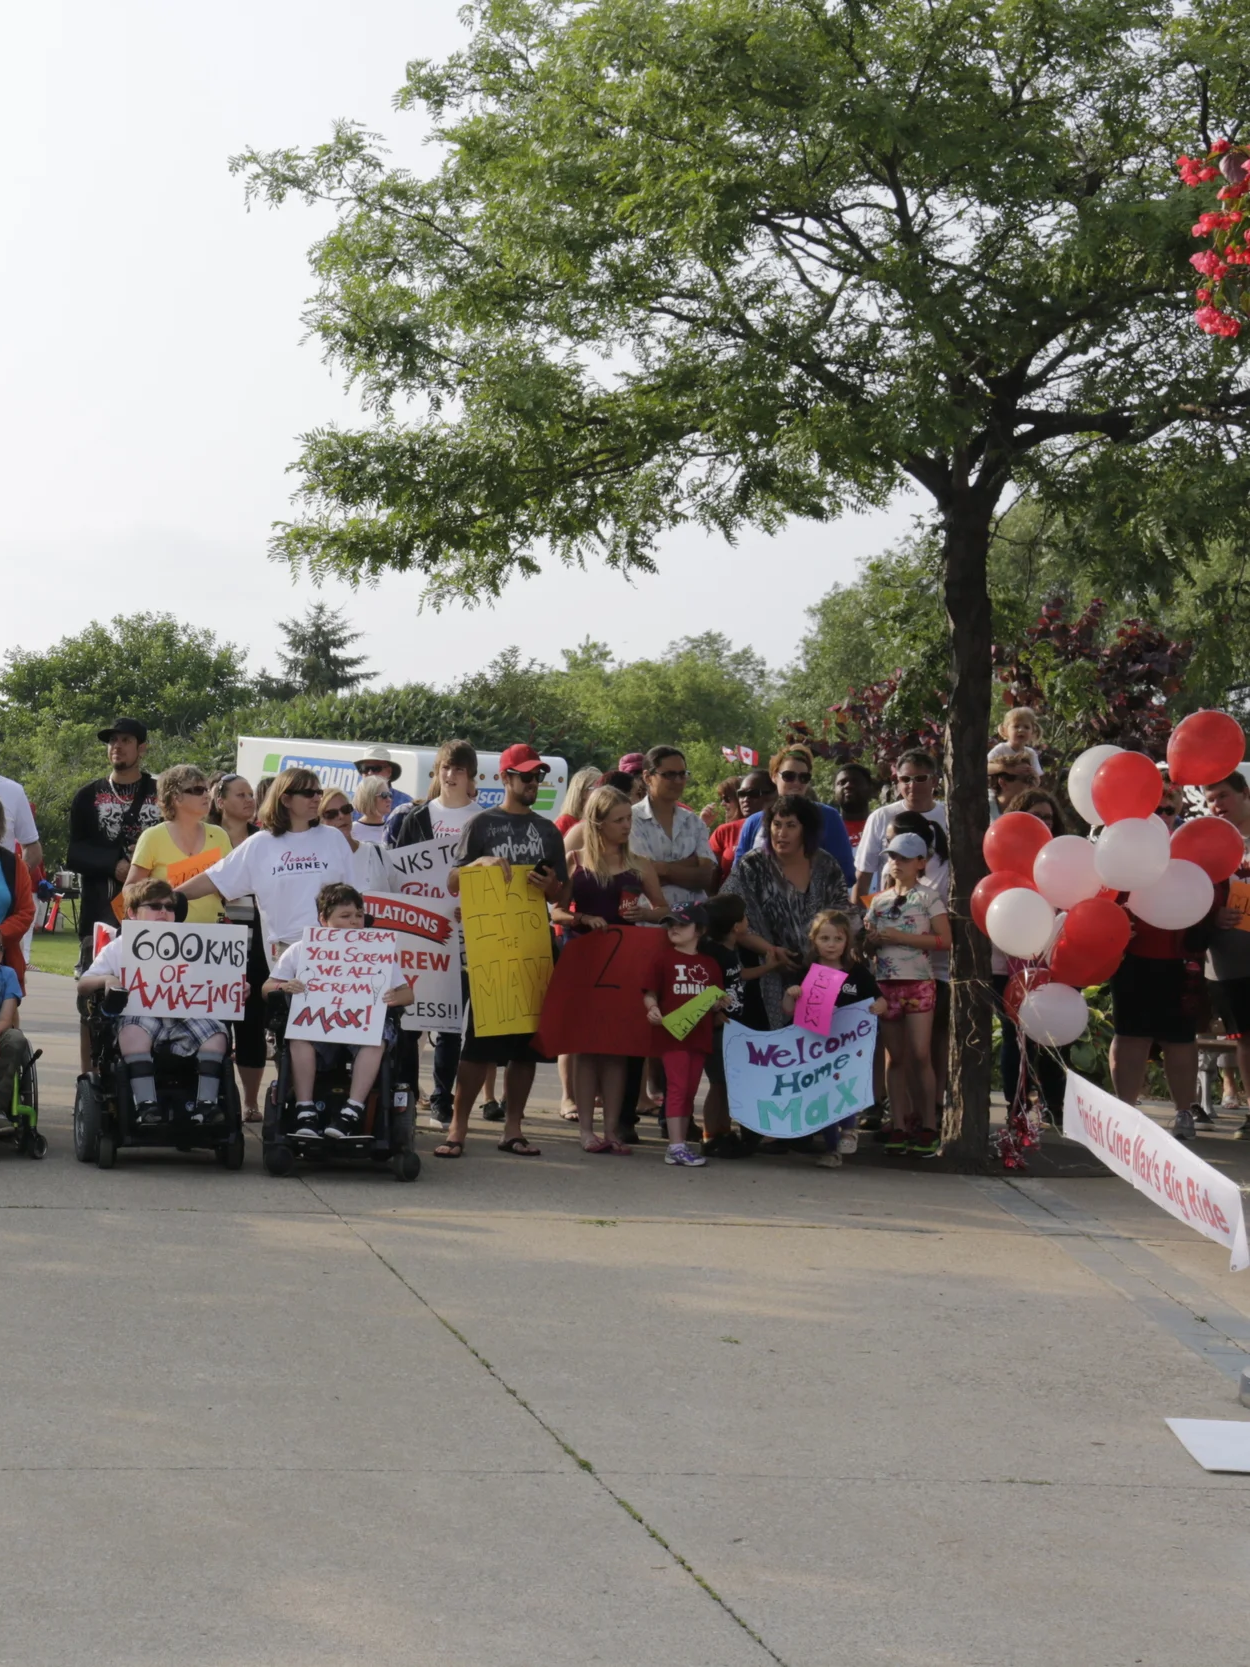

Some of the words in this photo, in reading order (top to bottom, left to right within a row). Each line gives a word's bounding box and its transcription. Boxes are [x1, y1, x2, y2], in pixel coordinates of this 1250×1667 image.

[281, 851, 317, 866] Jesse's
[364, 902, 438, 934] ULATIONS
[467, 912, 506, 940] IT
[515, 911, 542, 932] TO
[310, 928, 340, 942] ICE
[344, 930, 396, 942] CREAM
[498, 937, 519, 949] THE
[306, 947, 340, 960] YOU
[343, 947, 393, 965] SCREAM
[594, 928, 623, 989] 2
[160, 964, 189, 983] OF
[317, 965, 342, 977] WE
[347, 966, 377, 978] ALL
[674, 965, 688, 981] I
[307, 978, 372, 994] SCREAM
[472, 957, 550, 1029] MAX
[673, 984, 711, 995] CANA
[804, 969, 833, 1027] MAX
[331, 996, 344, 1010] 4
[292, 1005, 372, 1035] MAX!
[746, 1020, 872, 1068] Welcome
[771, 1053, 850, 1096] Home
[757, 1076, 859, 1133] Max
[1077, 1095, 1105, 1148] Finish
[1106, 1117, 1131, 1167] Line
[1132, 1135, 1161, 1193] Max's
[1163, 1160, 1190, 1220] Big
[1187, 1176, 1230, 1234] Ride
